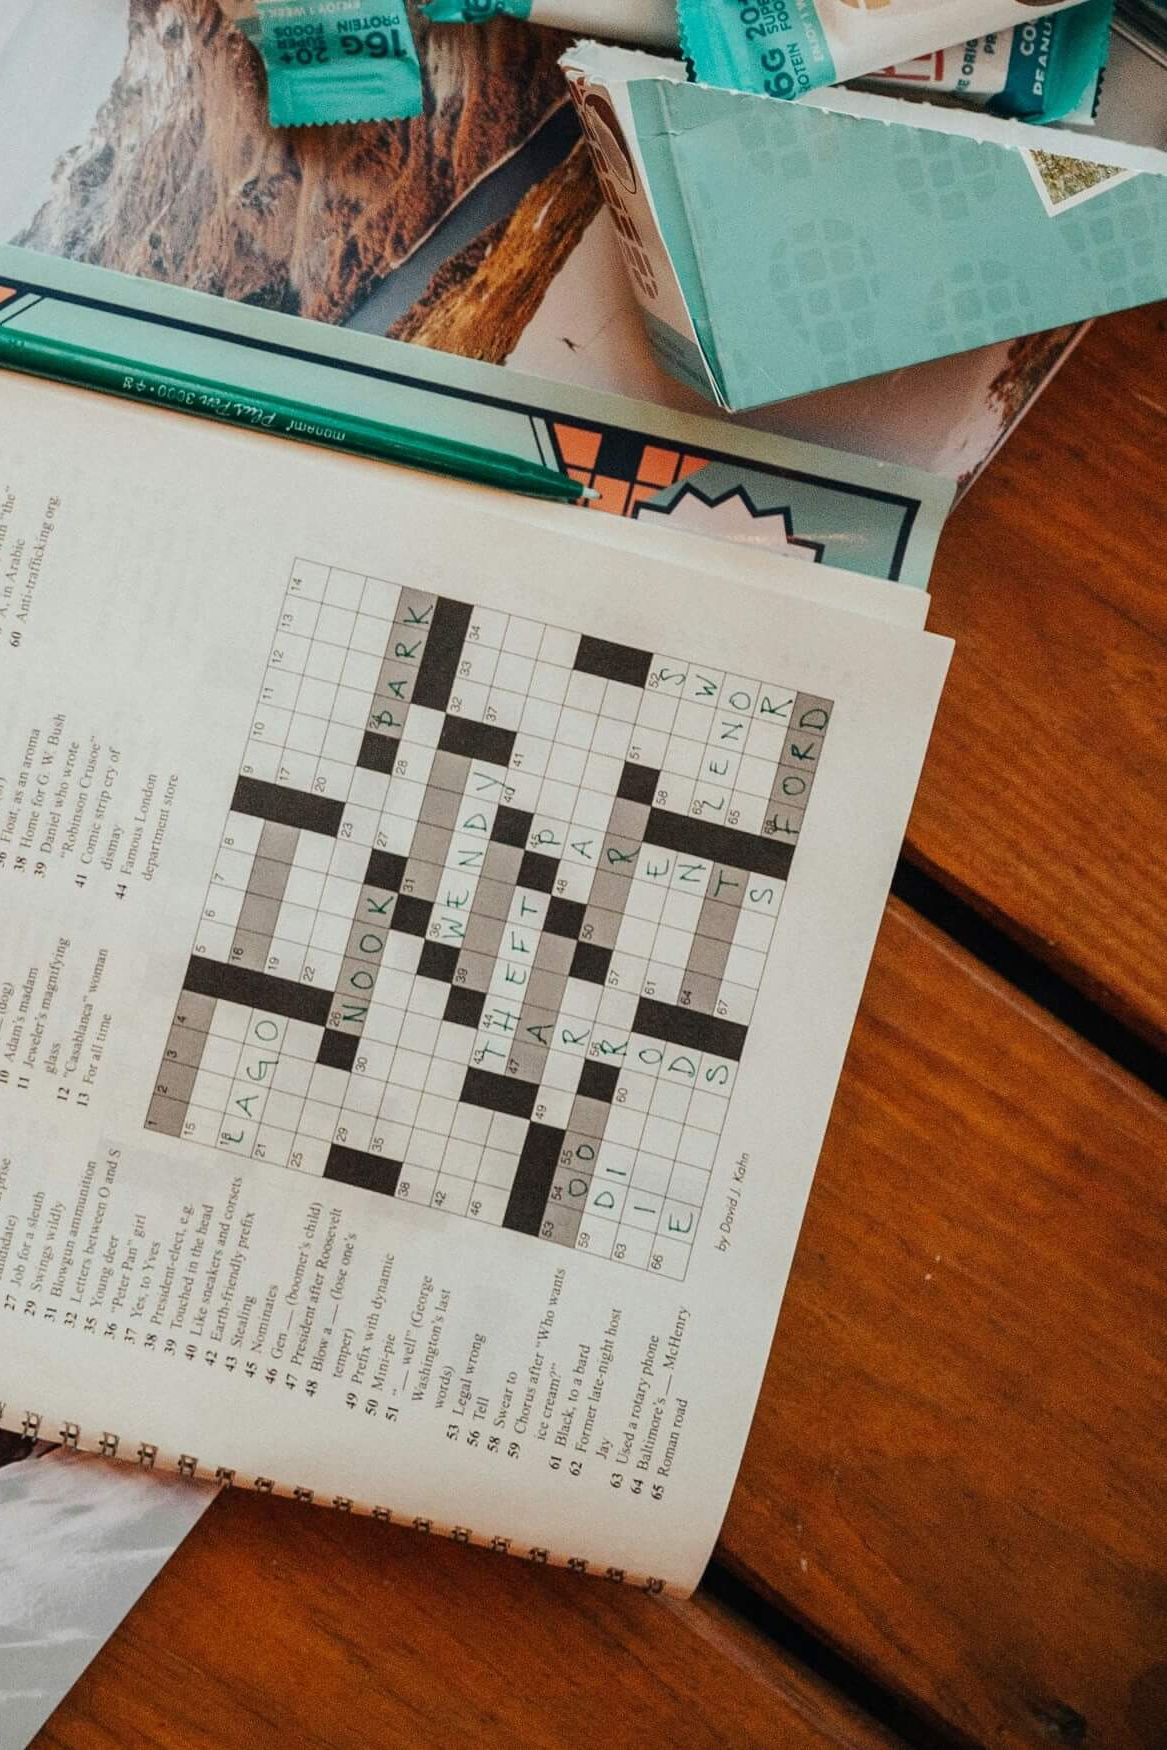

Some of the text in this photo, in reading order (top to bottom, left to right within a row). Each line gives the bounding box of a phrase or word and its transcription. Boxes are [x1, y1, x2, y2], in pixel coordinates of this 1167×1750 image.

[274, 23, 324, 36] FOODS
[338, 15, 399, 32] PROTEIN
[341, 29, 406, 57] 16G
[196, 393, 233, 417] Pen
[230, 401, 278, 428] Plus
[284, 417, 346, 445] monami
[372, 600, 431, 732] PARK
[33, 740, 81, 880] 39 Daniel who wrote
[113, 773, 159, 901] 44 Famous London
[139, 773, 179, 882] department store
[433, 770, 517, 946] WENDY
[336, 889, 396, 1024] NOOK
[479, 892, 548, 1067] THEFT
[55, 1085, 72, 1103] 12
[87, 948, 109, 995] woman
[75, 1013, 113, 1108] 13 For all time
[717, 1196, 739, 1233] David
[731, 1150, 750, 1182] Kahn
[42, 1159, 98, 1324] 31 Blowgun ammunition
[713, 1234, 731, 1253] by
[223, 1295, 258, 1373] 43 Stealing
[284, 1207, 343, 1392] 47 President after Roosevelt
[364, 1332, 397, 1417] 50 Mini-pie
[445, 1332, 488, 1442] 53 Legal wrong
[609, 1334, 660, 1489] 63 Used a rotary phone
[650, 1397, 689, 1501] 65 Roman road
